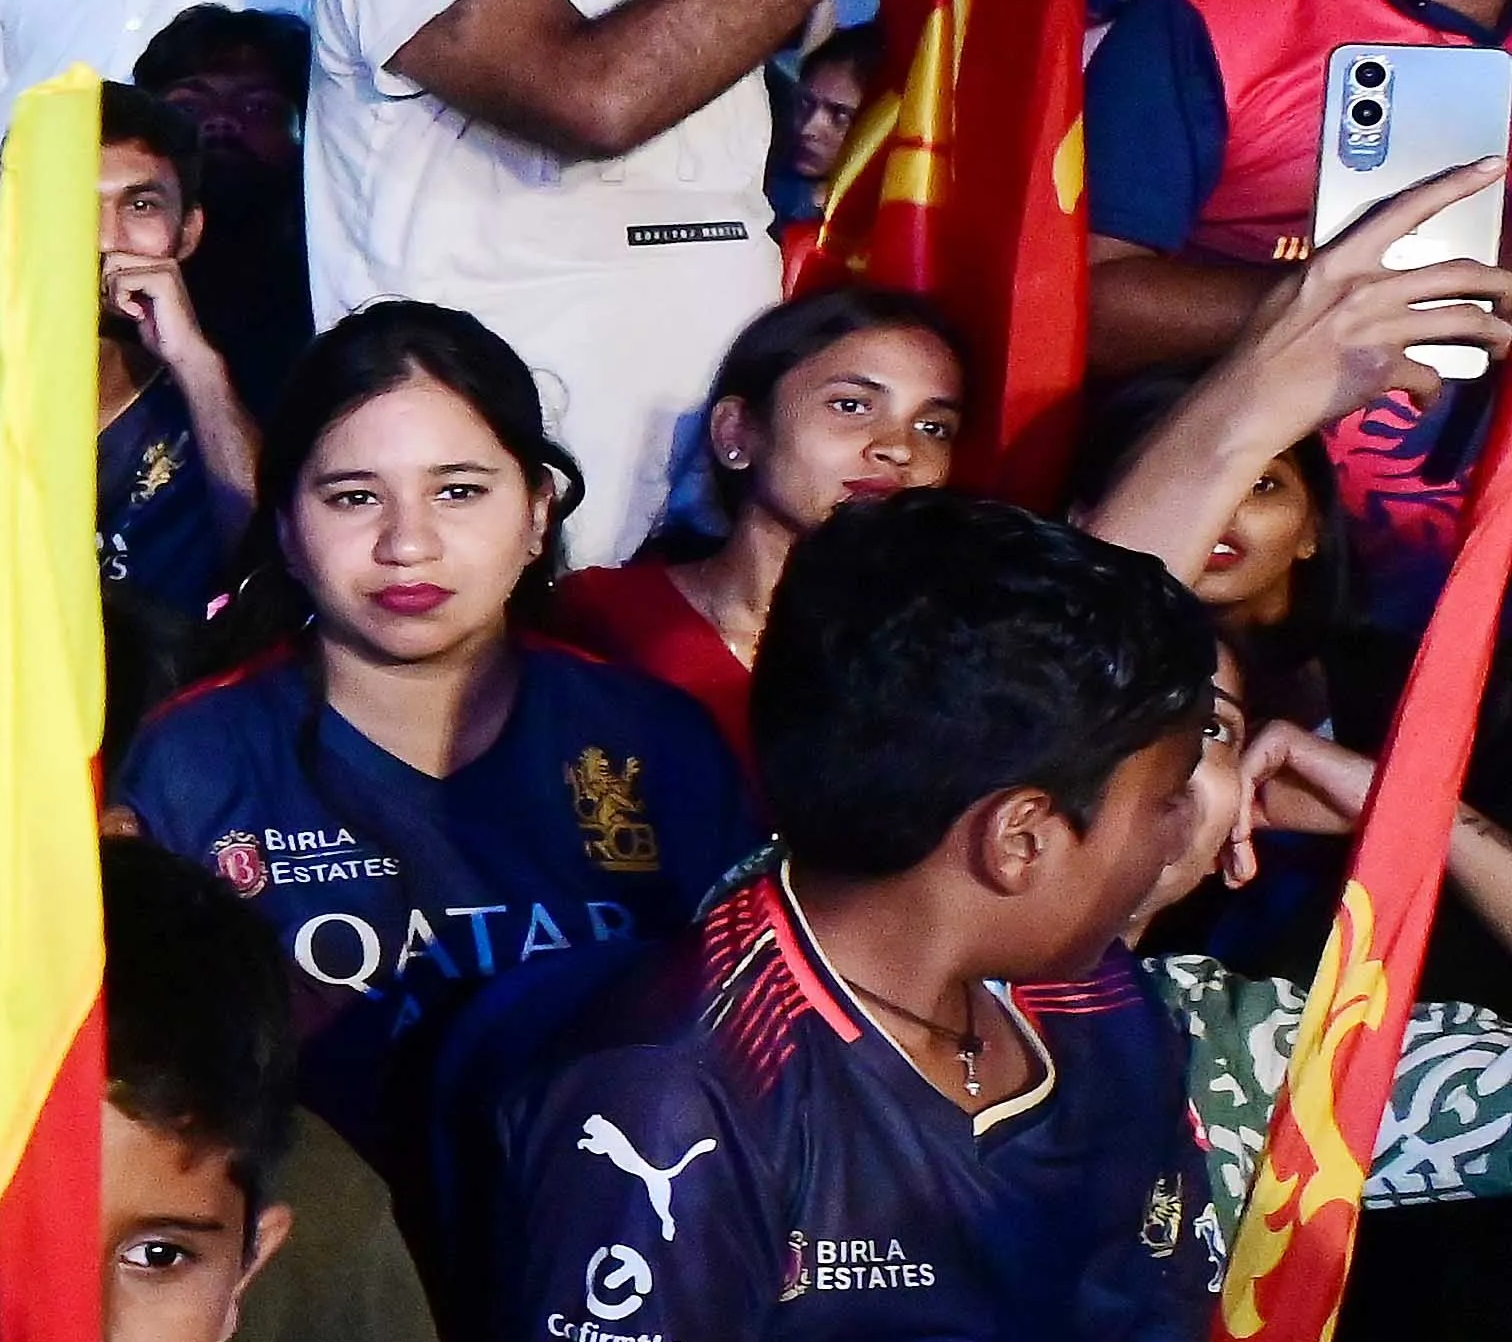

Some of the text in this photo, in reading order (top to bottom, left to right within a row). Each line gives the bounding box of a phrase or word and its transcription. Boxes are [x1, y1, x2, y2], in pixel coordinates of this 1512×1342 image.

[264, 827, 357, 851] BIRLA
[270, 857, 400, 885] ESTATES
[293, 900, 637, 1001] QATAR
[816, 1238, 906, 1264] BIRLA
[815, 1263, 936, 1291] ESTATES
